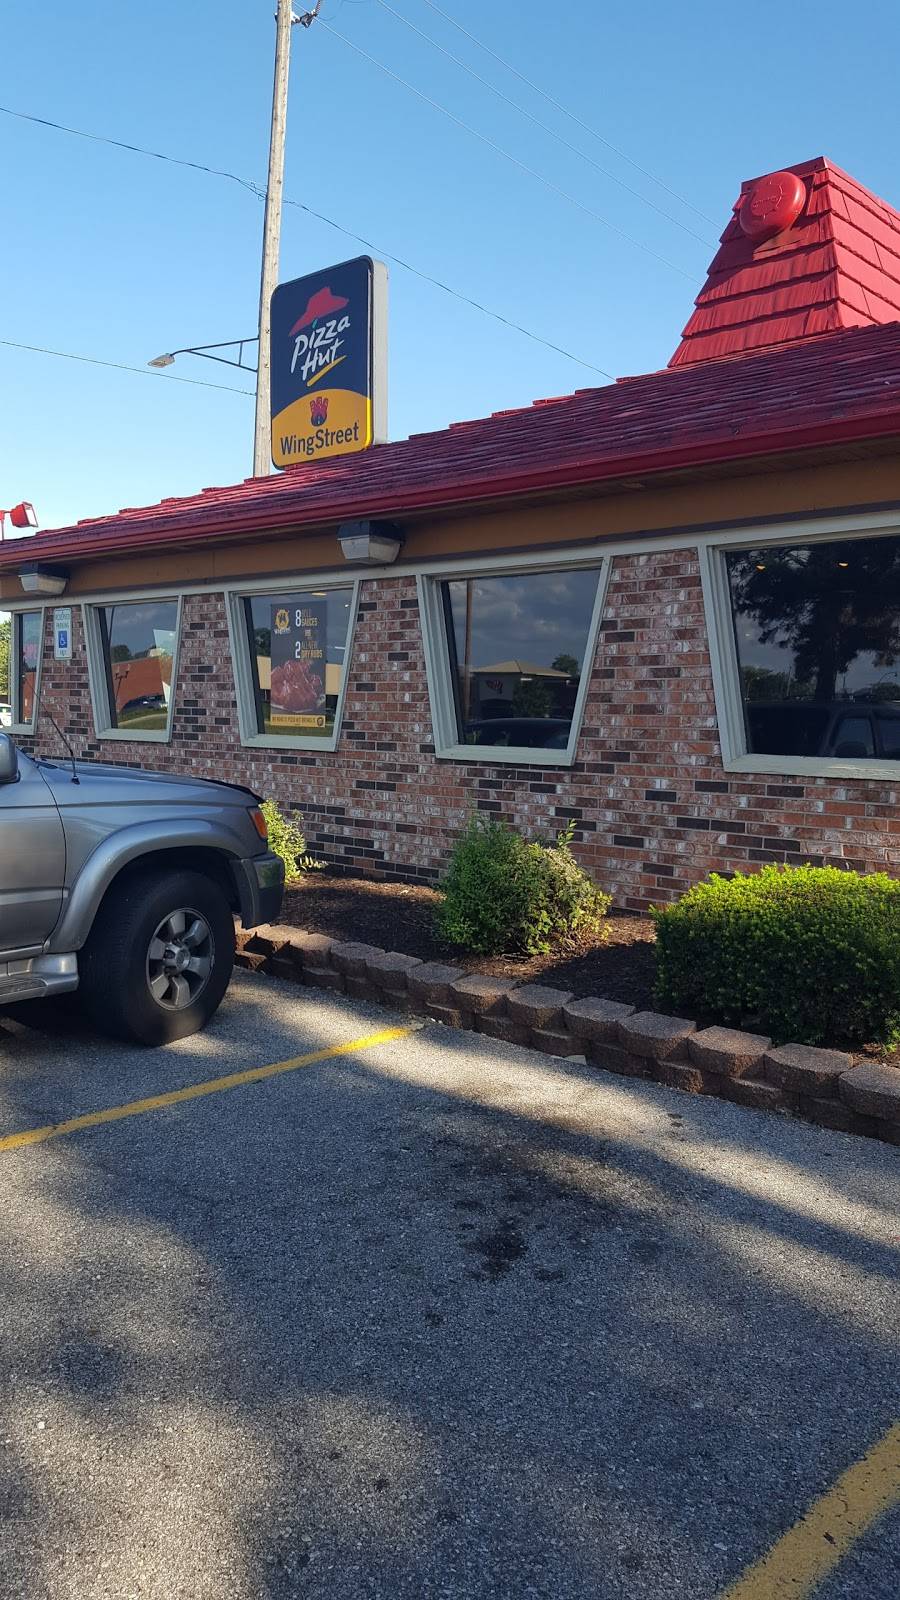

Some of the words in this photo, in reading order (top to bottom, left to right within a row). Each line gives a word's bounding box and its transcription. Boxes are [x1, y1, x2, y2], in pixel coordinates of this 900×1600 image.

[290, 316, 351, 374] Pizza
[300, 337, 345, 381] Hut
[280, 421, 360, 456] WingStreet
[295, 609, 302, 627] 8
[295, 641, 301, 659] 2
